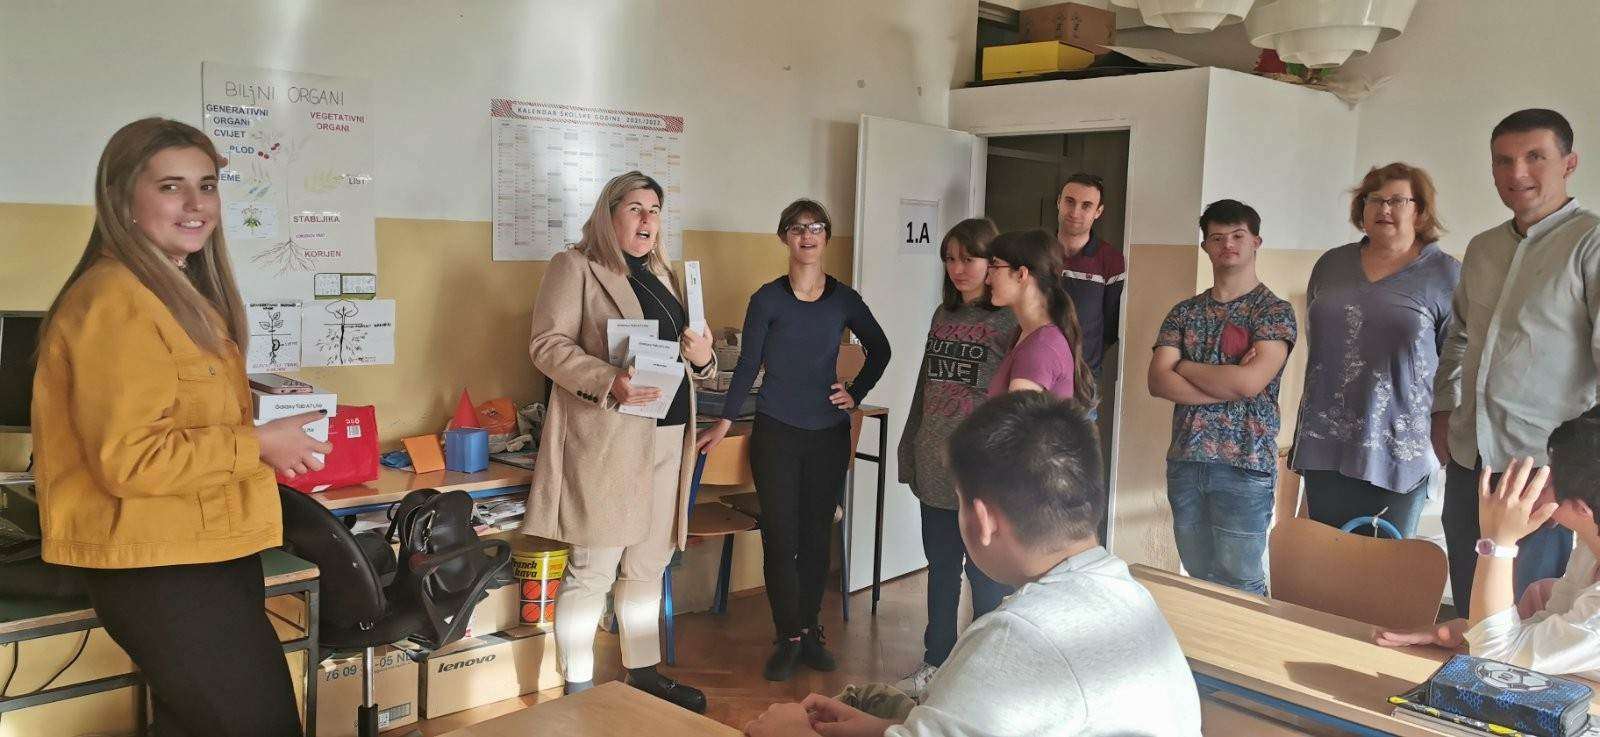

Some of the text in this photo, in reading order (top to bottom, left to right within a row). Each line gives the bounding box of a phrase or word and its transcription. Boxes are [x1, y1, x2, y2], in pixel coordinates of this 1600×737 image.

[288, 87, 344, 106] ORGANI
[206, 104, 269, 117] GENERATIVNI
[213, 116, 250, 127] ORGANI
[310, 111, 366, 124] VEGETATIVNI
[213, 129, 246, 138] CVIJET
[316, 123, 350, 132] ORGANI
[229, 145, 255, 155] PLOD
[293, 215, 340, 223] STABLJIKA
[906, 221, 930, 244] 1.A
[304, 250, 341, 258] KORIJEN
[961, 343, 984, 359] TO
[928, 358, 972, 383] LIVE
[325, 669, 339, 682] 76
[343, 664, 357, 677] 09
